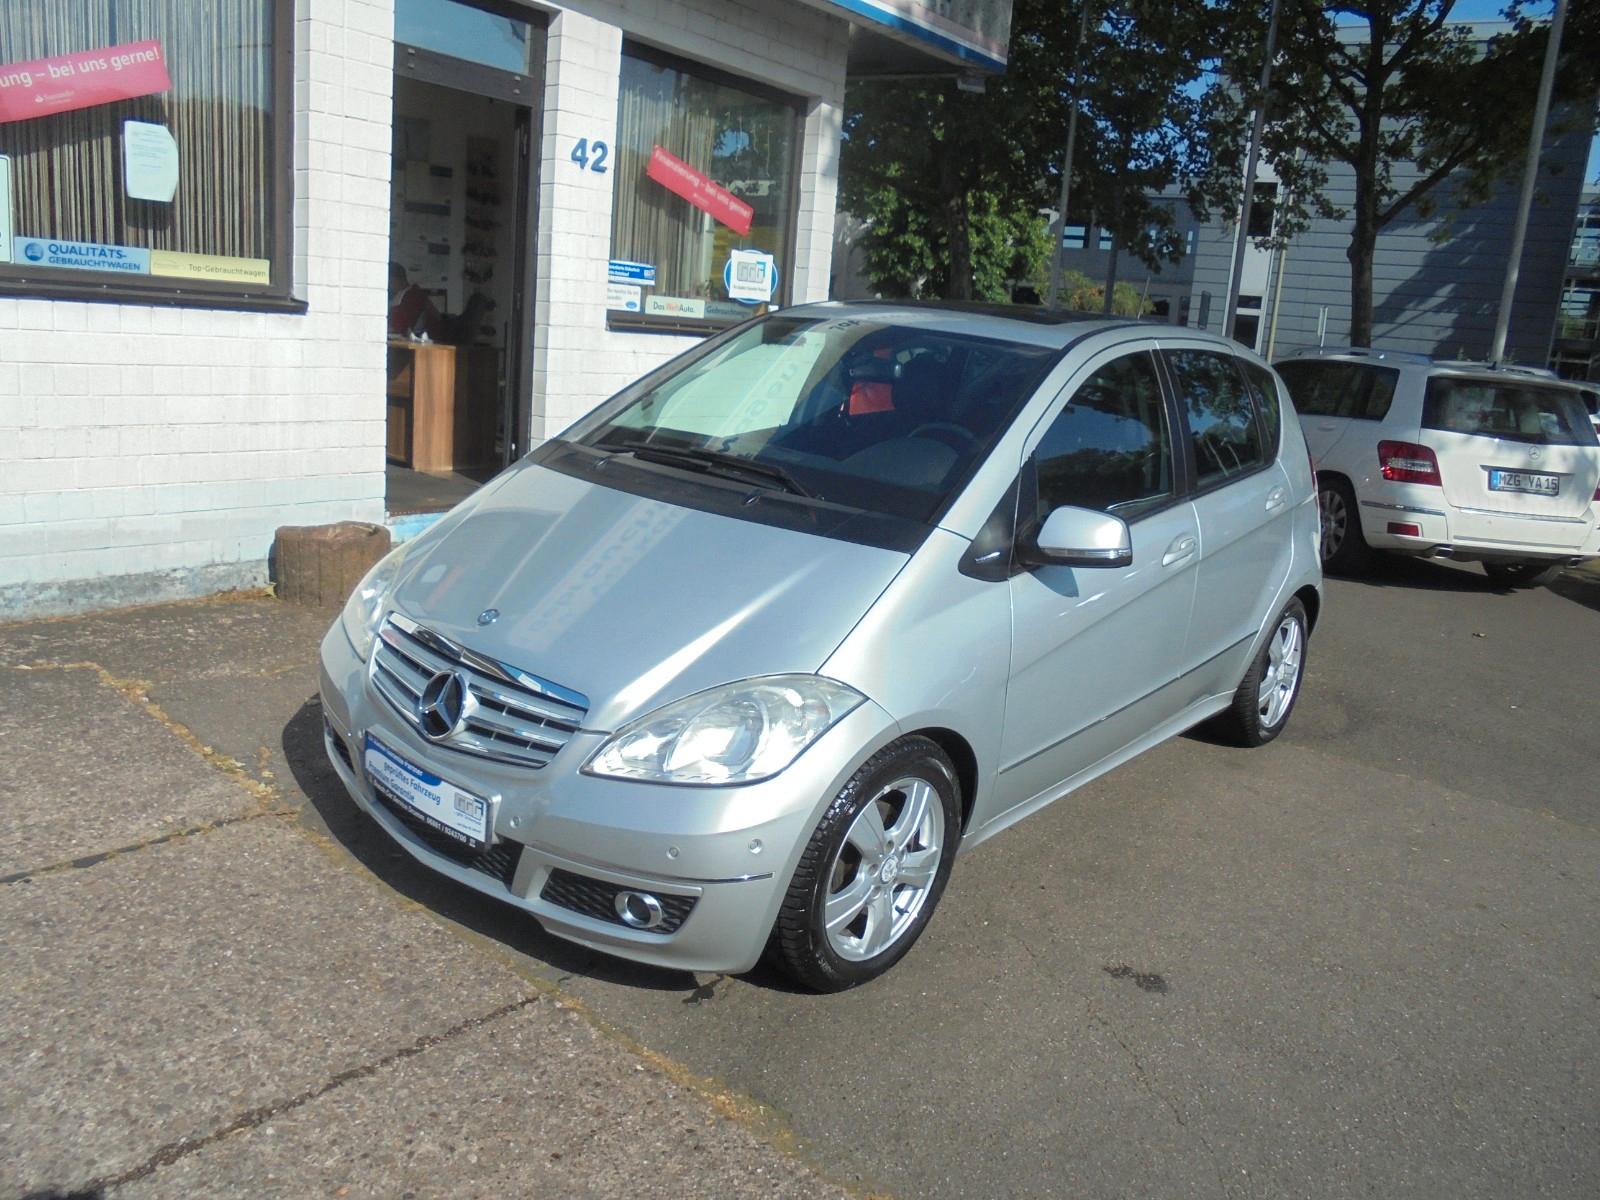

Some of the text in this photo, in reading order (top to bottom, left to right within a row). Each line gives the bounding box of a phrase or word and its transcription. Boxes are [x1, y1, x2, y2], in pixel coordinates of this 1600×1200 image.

[48, 60, 75, 78] bei
[79, 57, 108, 73] uns
[110, 46, 160, 72] gerne!
[571, 137, 608, 173] 42
[48, 243, 127, 260] QUALITÄTS-
[48, 256, 141, 271] GEBRAUCHTWAGEN
[189, 263, 266, 277] Top-Gebrauchtwagen
[653, 301, 665, 311] Das
[1498, 473, 1521, 487] MZG
[410, 779, 441, 805] Fahrzeug
